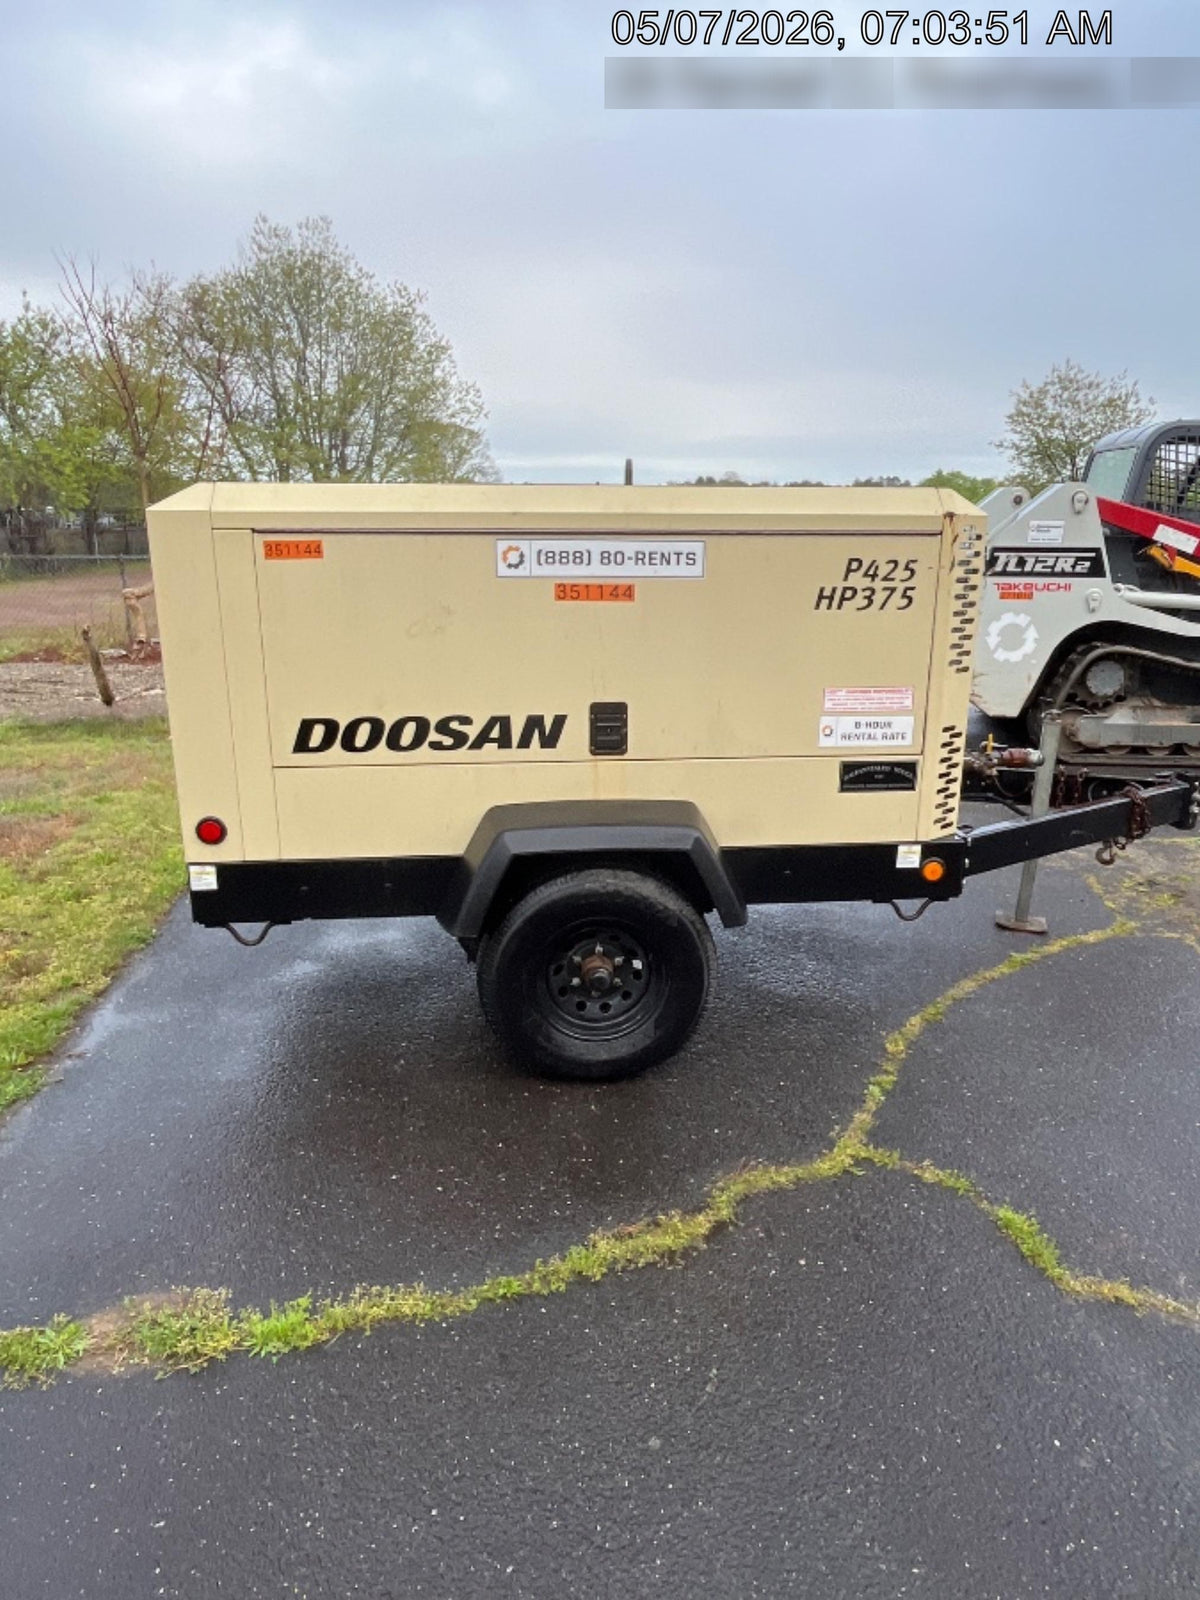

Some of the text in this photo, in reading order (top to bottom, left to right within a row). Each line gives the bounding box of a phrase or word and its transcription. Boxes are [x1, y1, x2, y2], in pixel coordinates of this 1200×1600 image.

[264, 541, 323, 558] 351144
[537, 550, 698, 567] (888) 80-RENTS
[842, 557, 919, 583] P425
[556, 583, 634, 601] 351144
[814, 586, 917, 611] HP375
[291, 713, 568, 754] DOOSAN
[840, 731, 908, 742] RENTAL RATE
